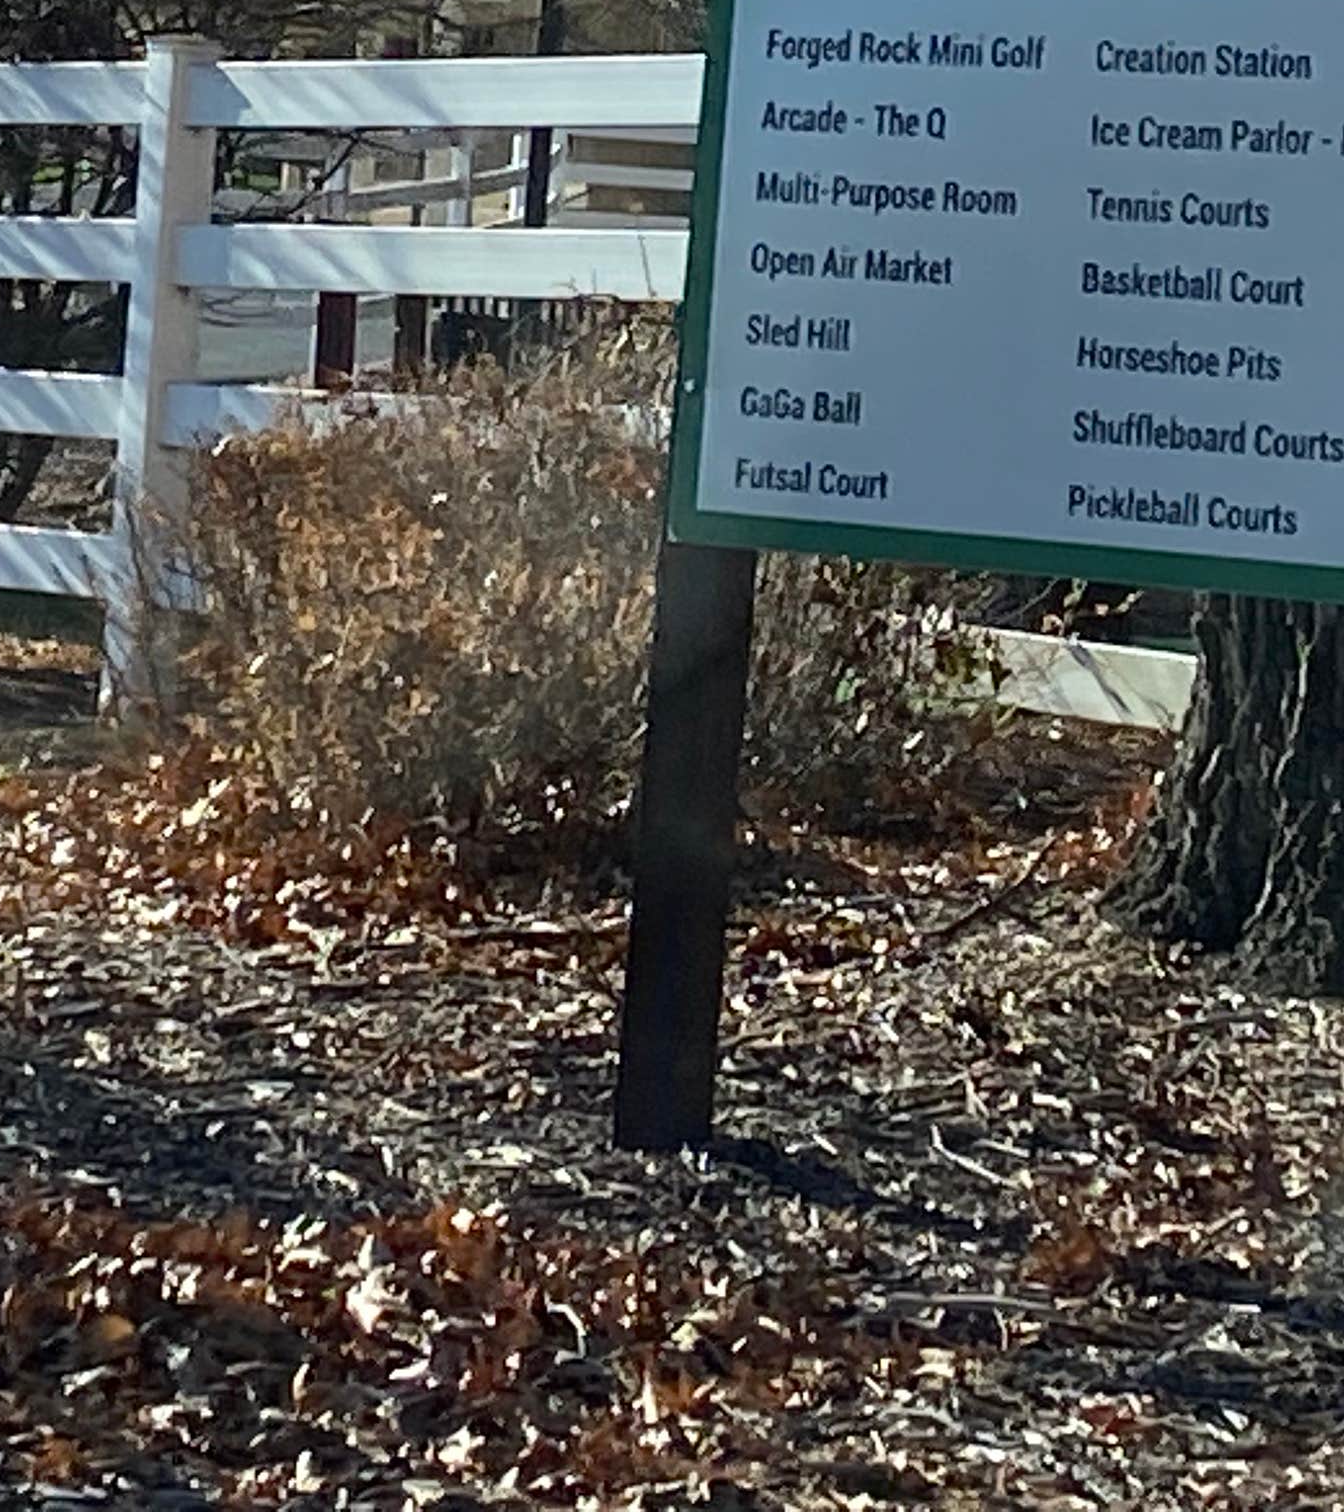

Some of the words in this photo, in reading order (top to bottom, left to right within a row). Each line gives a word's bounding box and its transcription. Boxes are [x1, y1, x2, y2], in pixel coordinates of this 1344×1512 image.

[766, 28, 853, 70] Forged
[859, 31, 922, 65] Rock
[928, 34, 983, 68] Mini
[990, 35, 1045, 70] Golf
[1096, 39, 1207, 75] Creation
[1214, 44, 1312, 80] Station
[760, 99, 848, 135] Arcade
[874, 103, 921, 138] The
[926, 106, 947, 141] Q
[1091, 113, 1131, 147] Ice
[1137, 115, 1223, 152] Cream
[1230, 119, 1314, 155] Parlor
[756, 171, 936, 217] Multi-Purpose
[942, 181, 1017, 217] Room
[1086, 187, 1174, 223] Tennis
[1179, 192, 1270, 229] Courts
[750, 242, 815, 281] Open
[820, 246, 859, 279] Air
[864, 248, 952, 285] Market
[1081, 262, 1223, 302] Basketball
[1229, 270, 1305, 308] Court
[745, 313, 802, 348] Sled
[807, 316, 851, 352] Hill
[1076, 336, 1220, 378] Horseshoe
[1226, 346, 1282, 382] Pits
[740, 385, 806, 421] GaGa
[812, 391, 862, 426] Ball
[1072, 409, 1247, 455] Shuffleboard
[1253, 424, 1344, 463] Courts
[735, 457, 812, 494] Futsal
[818, 463, 889, 500] Court
[1068, 484, 1200, 527] Pickleball
[1206, 496, 1298, 536] Courts
